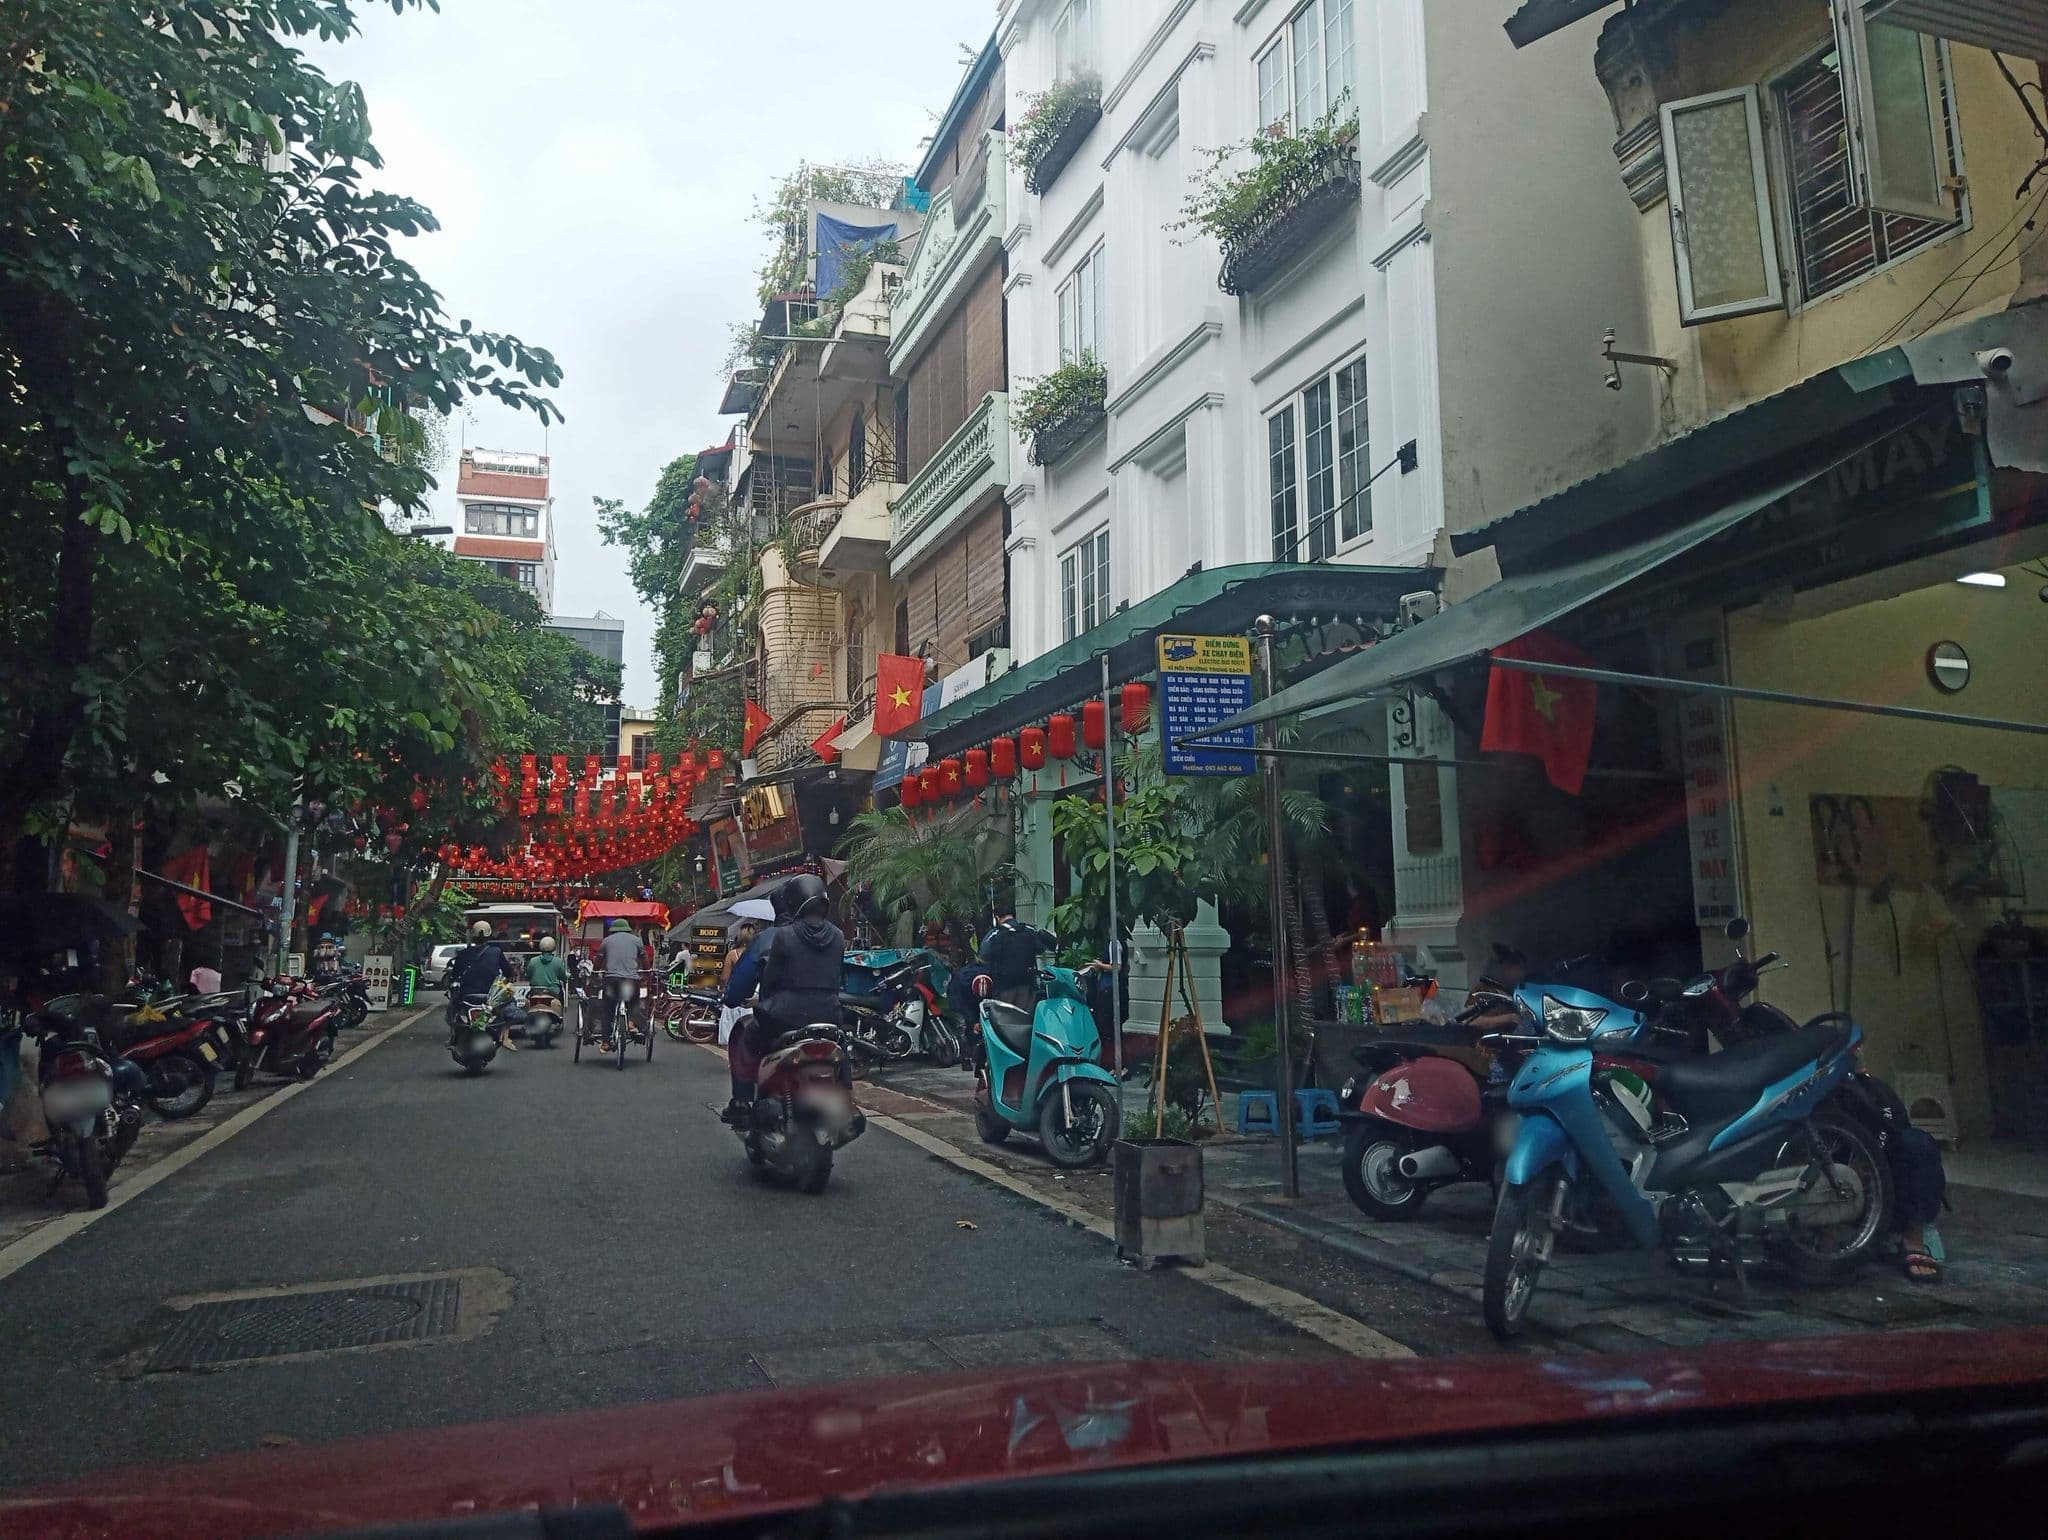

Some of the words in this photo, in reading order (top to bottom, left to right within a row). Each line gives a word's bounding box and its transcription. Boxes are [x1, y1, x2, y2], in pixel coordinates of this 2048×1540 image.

[501, 881, 525, 890] CENTER
[699, 928, 719, 936] BODY
[698, 944, 718, 953] FOOT
